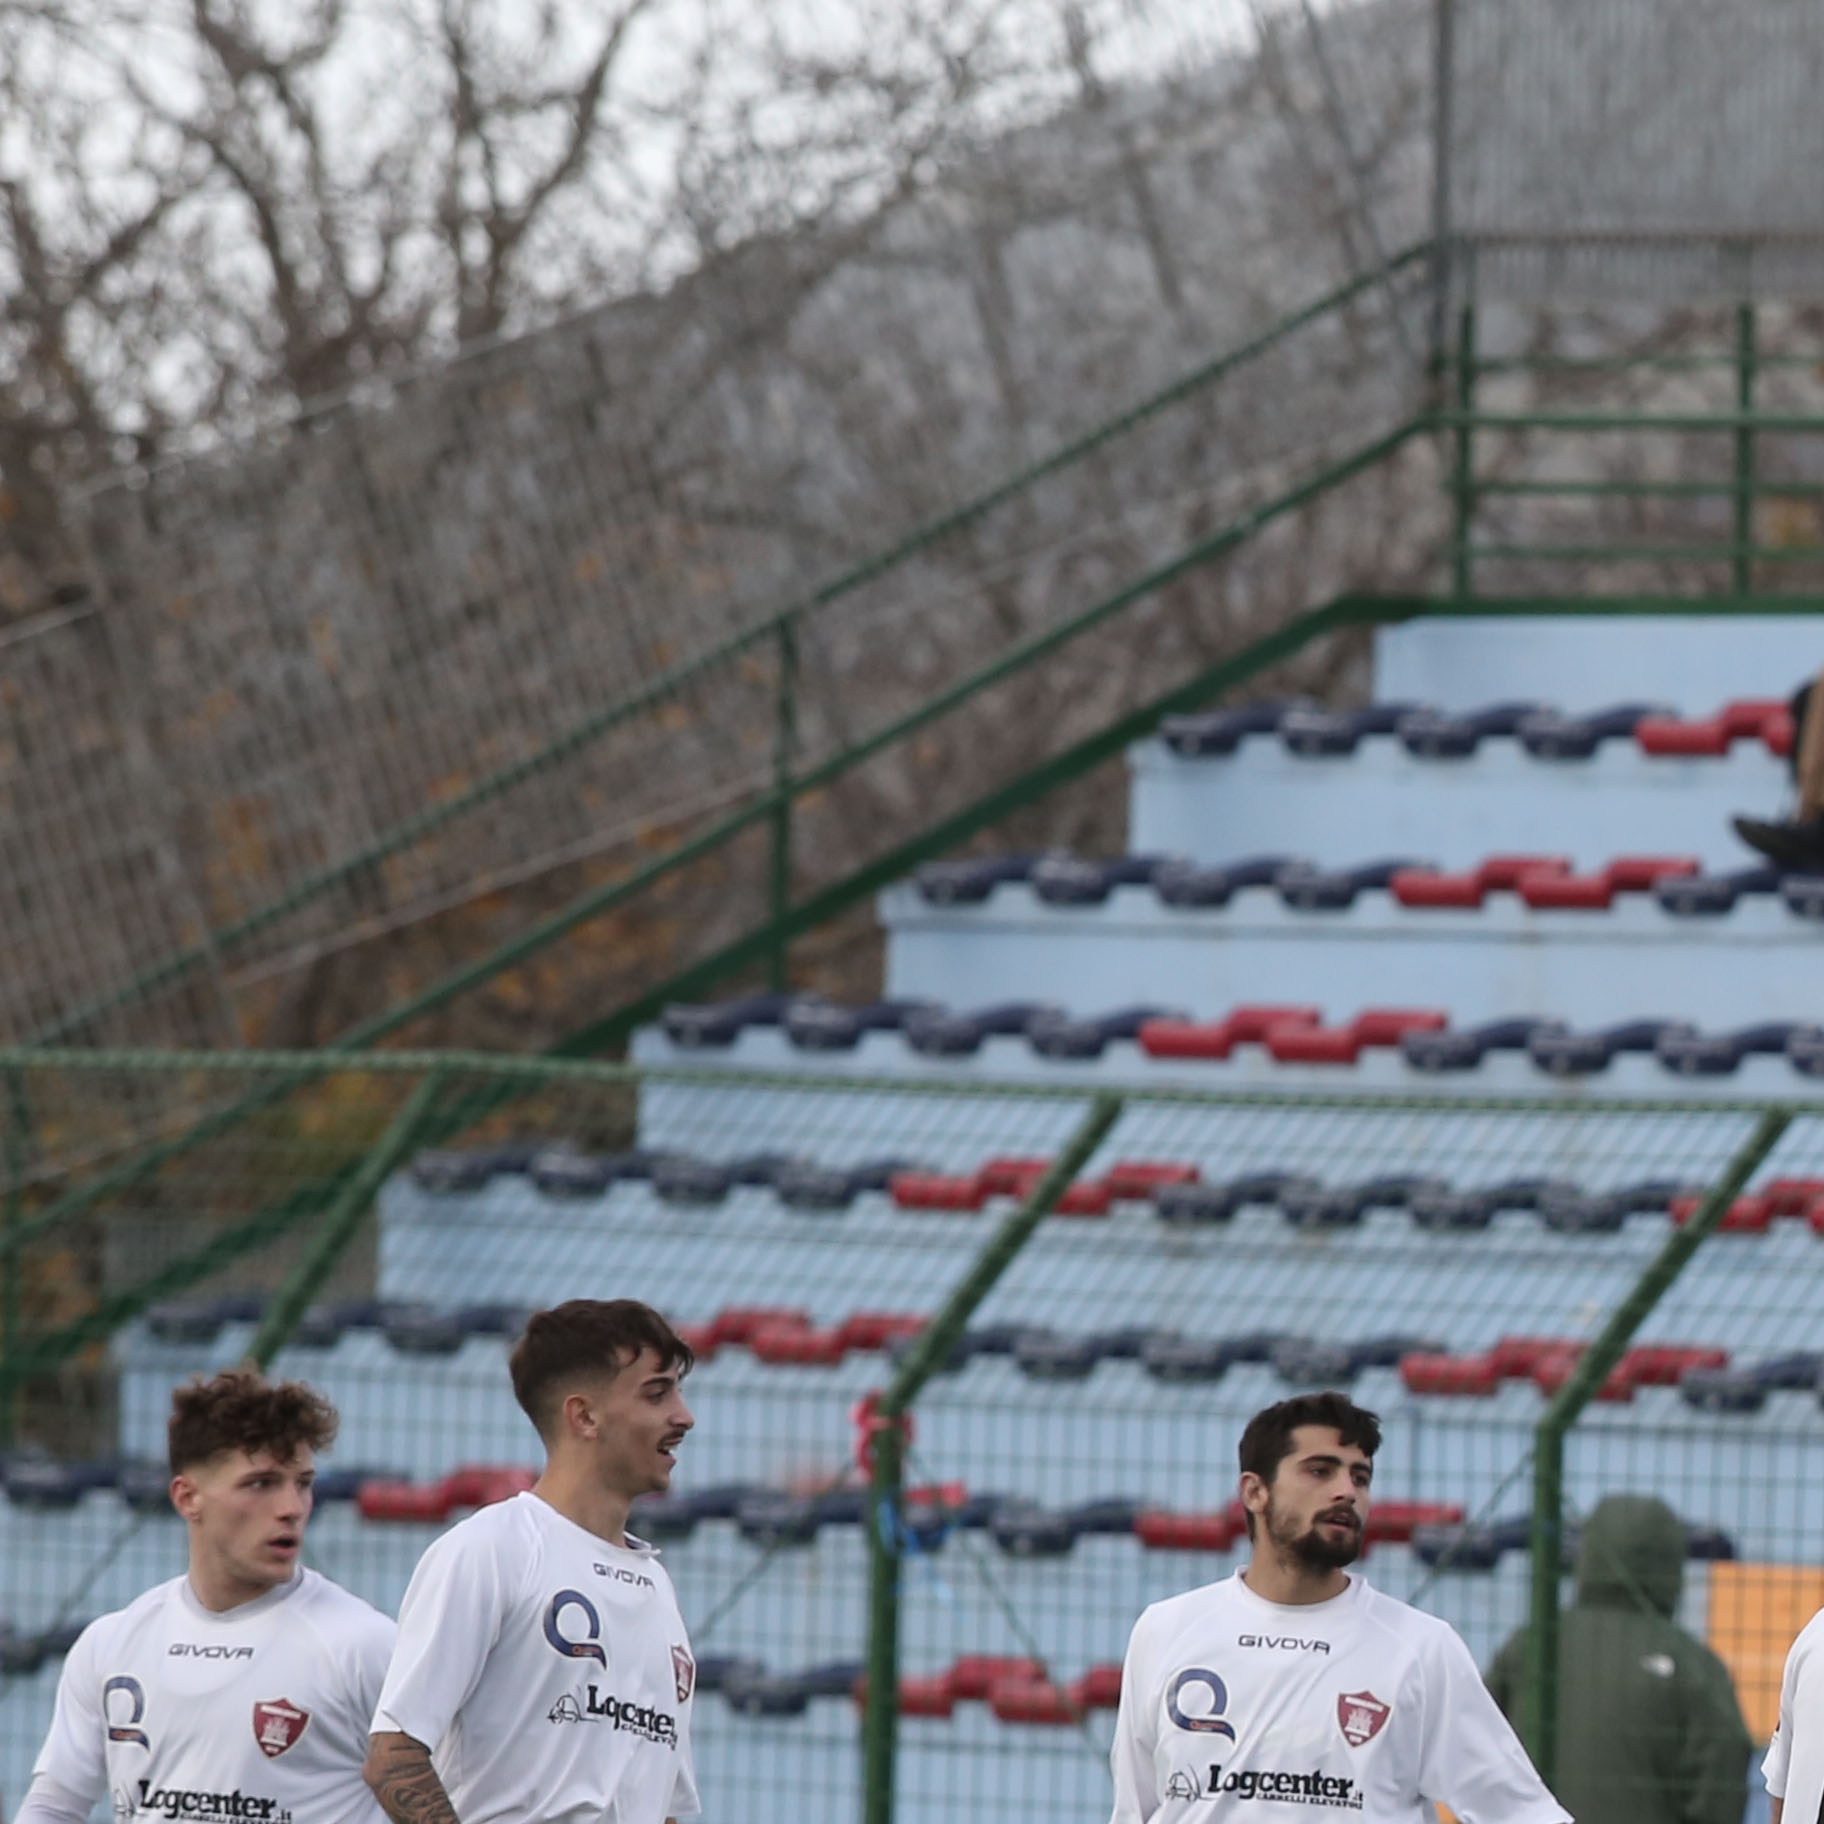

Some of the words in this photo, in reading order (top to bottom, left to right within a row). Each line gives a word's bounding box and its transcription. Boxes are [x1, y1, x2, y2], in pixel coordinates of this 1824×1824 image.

[593, 1563, 654, 1589] GIVOVA
[168, 1643, 254, 1660] GIVOVA
[1238, 1635, 1331, 1655] GIVOVA
